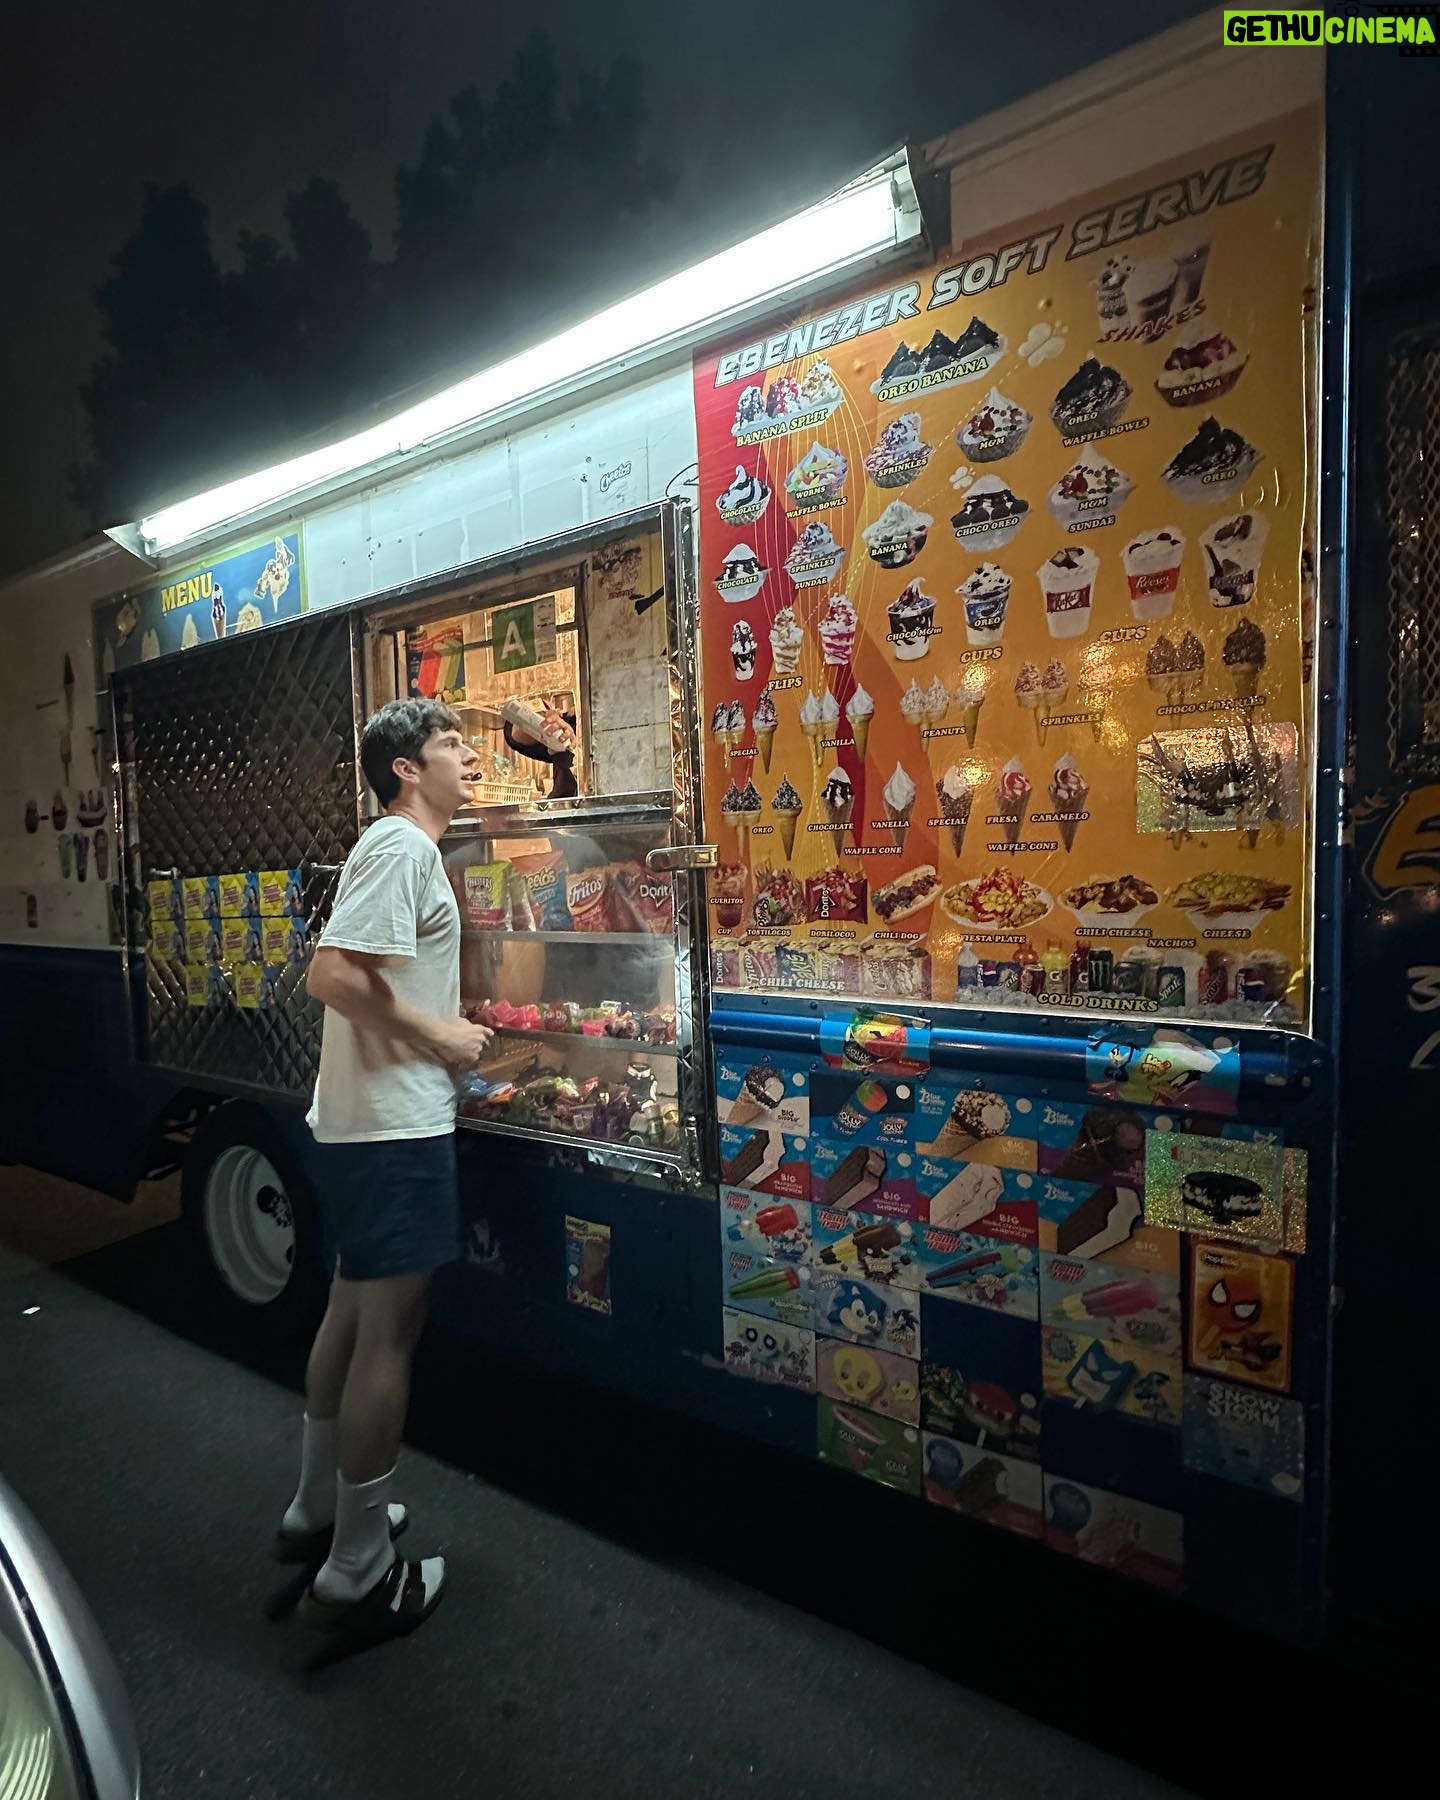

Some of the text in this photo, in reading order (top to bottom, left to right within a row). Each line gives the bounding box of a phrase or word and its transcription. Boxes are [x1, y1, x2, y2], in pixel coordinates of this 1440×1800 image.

[714, 143, 1276, 389] EBENEZER SOFT SERVE
[1096, 298, 1207, 344] SHAKES
[878, 357, 988, 402] OREO BANANA
[1172, 378, 1222, 399] BANANA
[1068, 411, 1098, 426] OREO
[736, 408, 828, 447] BANANA SPLIT
[1063, 418, 1149, 448] WAFFLE BOWLS
[877, 457, 928, 478] SPRINKLES
[600, 463, 632, 492] Cheetos
[1202, 469, 1237, 485] OREO
[795, 486, 826, 499] WORMS
[721, 503, 762, 520] CHOCOLATE
[786, 497, 847, 519] WAFFLE BOWLS
[956, 517, 1019, 538] CHOCO OREO
[1068, 515, 1116, 533] SUNDAE
[871, 542, 908, 556] BANANA
[790, 558, 835, 574] SPRINKLES
[717, 574, 759, 591] CHOCOLATE
[794, 576, 828, 590] SUNDAE
[161, 572, 213, 613] MENU
[973, 617, 1001, 628] OREO
[501, 620, 528, 660] A
[886, 630, 917, 643] CHOCO
[1100, 626, 1147, 643] CUPS
[960, 647, 1003, 663] CUPS
[767, 677, 803, 692] FLIPS
[1157, 703, 1196, 716] CHOCO
[1041, 713, 1101, 727] SPRINKLES
[922, 726, 966, 738] PEANUTS
[820, 738, 856, 748] VANILLA
[729, 748, 759, 758] SPECIAL
[927, 818, 967, 827] SPECIAL
[986, 815, 1018, 824] FRESA
[1031, 811, 1089, 822] CARAMELO
[752, 826, 773, 835] OREO
[807, 823, 854, 832] CHOCOLATE
[844, 846, 902, 855] WAFFLE CONE
[987, 842, 1058, 851] WAFFLE CONE
[526, 868, 558, 889] eetos
[569, 877, 603, 907] Fritos
[821, 886, 830, 918] Dorito
[747, 929, 791, 937] TOSTILOCOS
[810, 930, 856, 938] DORILOCOS
[874, 931, 920, 940] CHILI DOG
[994, 935, 1026, 943] PLATE
[1075, 927, 1152, 938] CHILI CHEESE
[1202, 929, 1250, 938] CHEESE
[1147, 939, 1196, 949] NACHOS
[759, 976, 845, 991] CHILI CHEESE
[1038, 993, 1158, 1012] COLD DRINKS
[781, 1109, 794, 1117] BIG
[781, 1173, 796, 1183] BIG
[883, 1191, 901, 1202] BIG
[999, 1213, 1020, 1225] BIG
